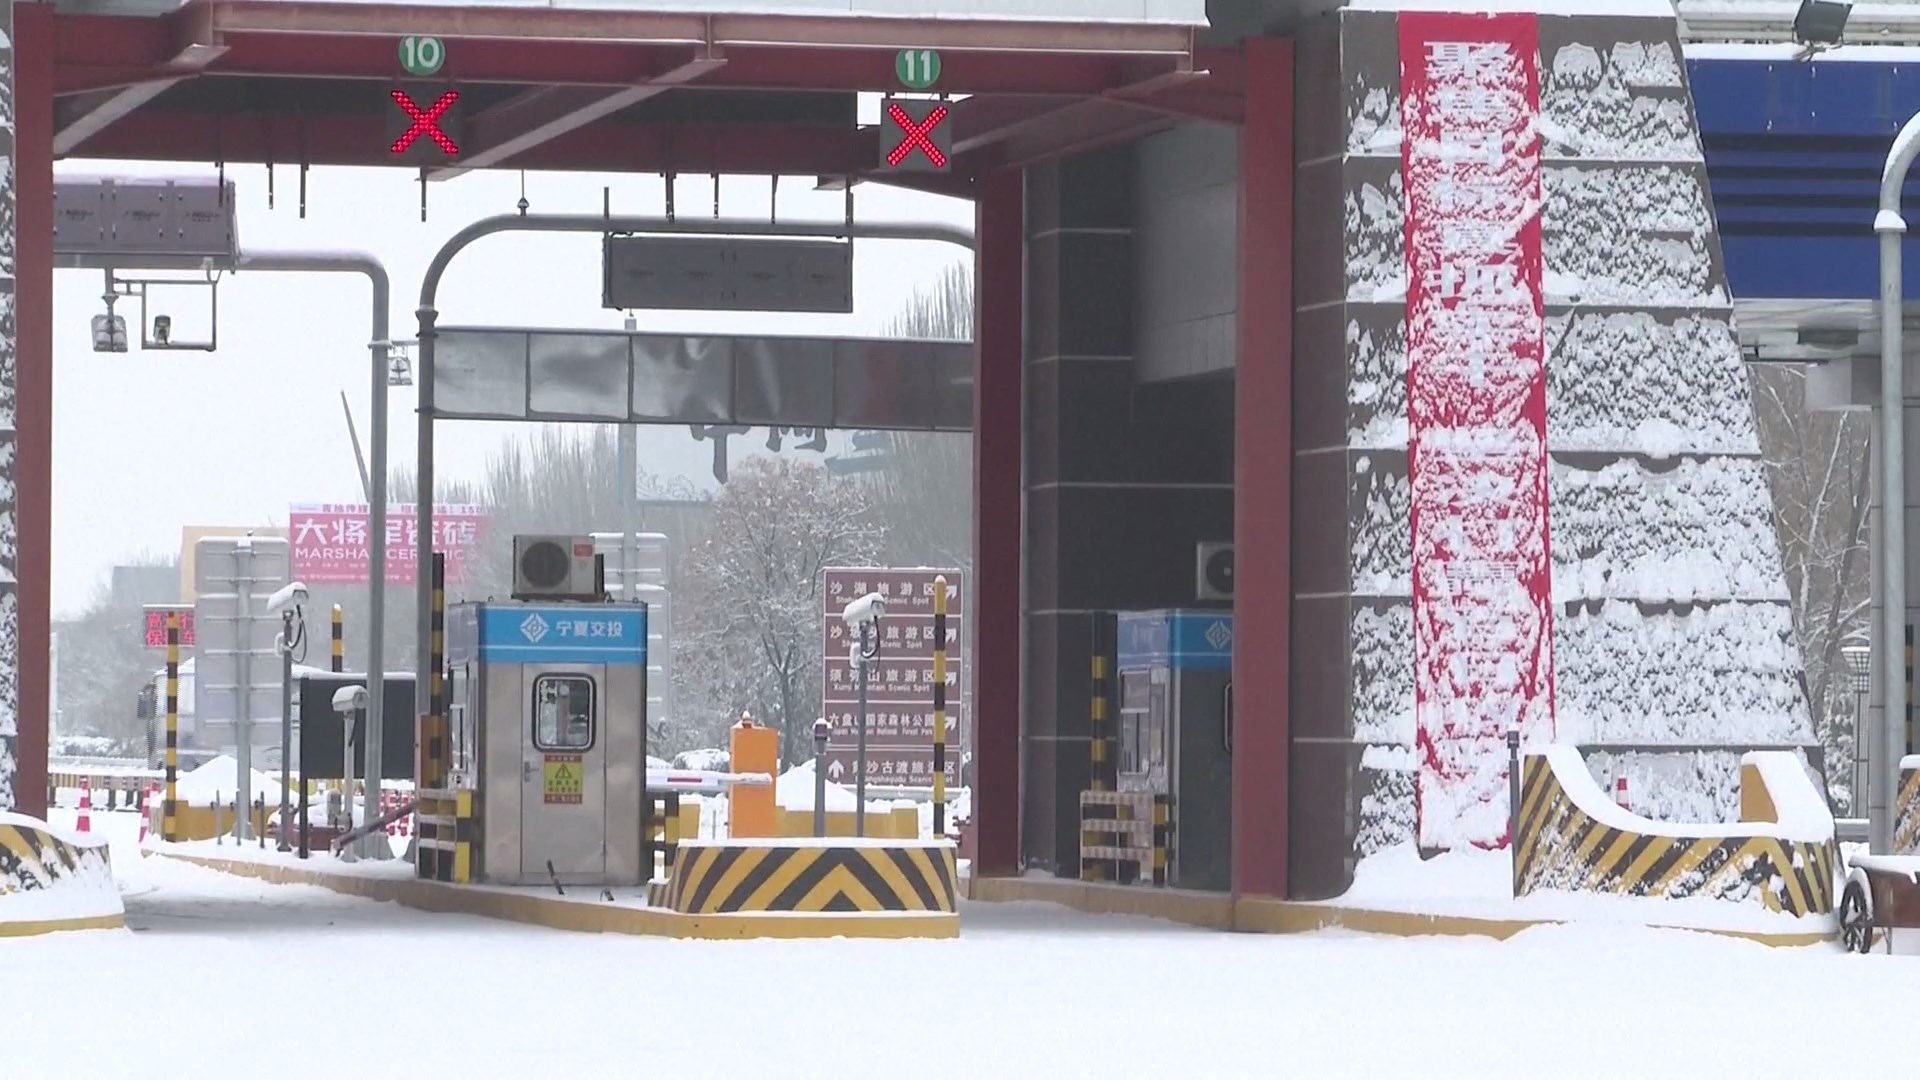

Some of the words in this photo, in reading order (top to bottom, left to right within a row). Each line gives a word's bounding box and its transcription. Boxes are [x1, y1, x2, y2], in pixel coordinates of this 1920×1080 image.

[405, 37, 440, 68] 10
[905, 50, 931, 81] 11
[295, 548, 371, 560] MARSHA
[386, 548, 465, 560] CERMIC
[830, 581, 935, 597] 沙湖旅游区
[912, 598, 930, 606] Spot
[556, 621, 623, 638] 宁夏交投
[906, 641, 923, 650] Spot
[854, 683, 886, 691] Mntain
